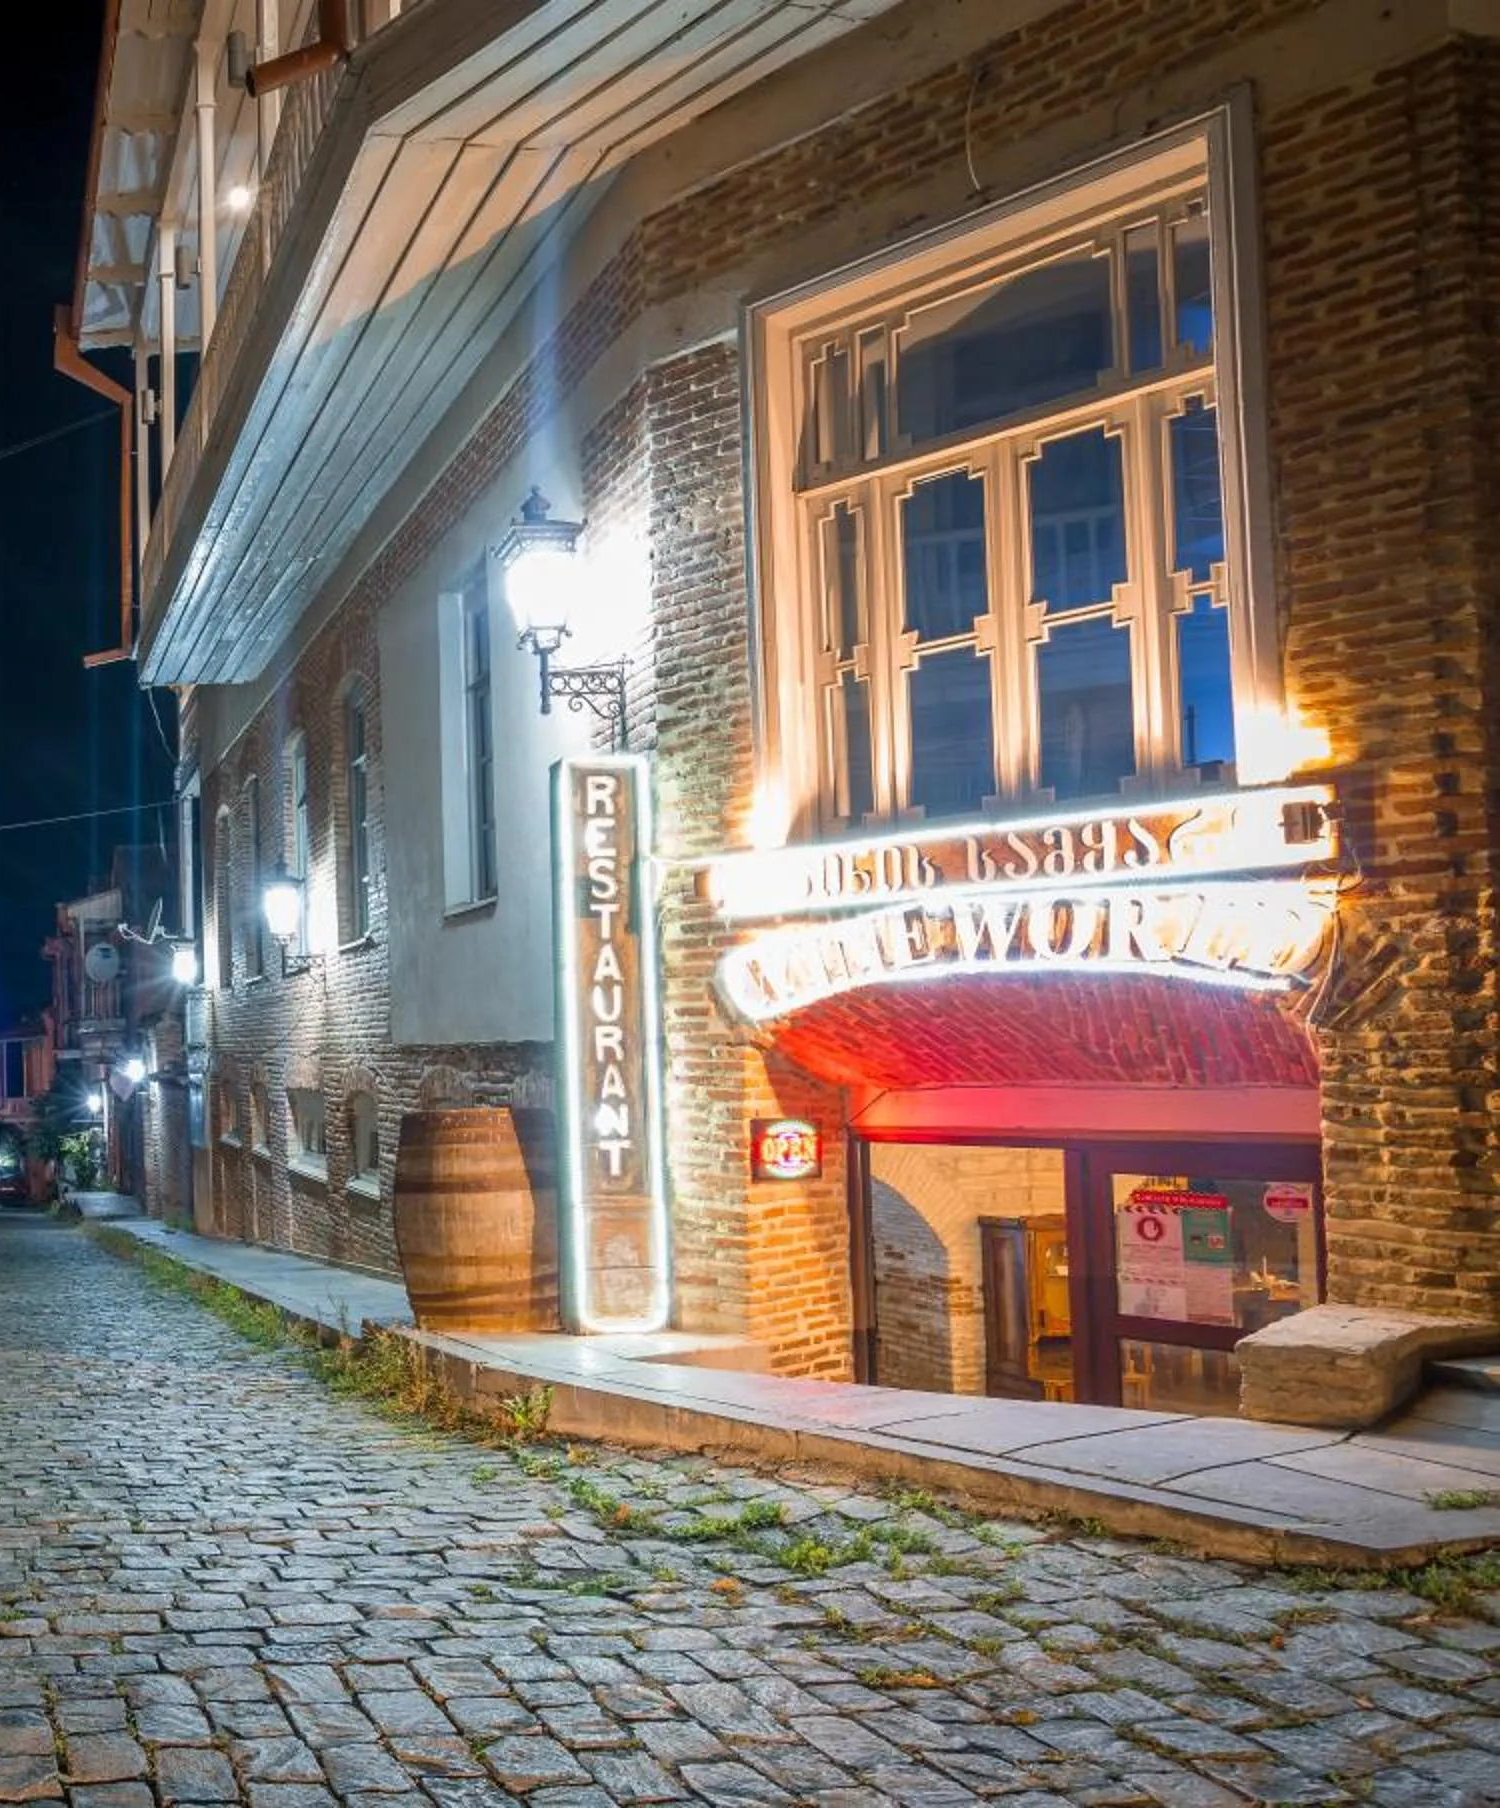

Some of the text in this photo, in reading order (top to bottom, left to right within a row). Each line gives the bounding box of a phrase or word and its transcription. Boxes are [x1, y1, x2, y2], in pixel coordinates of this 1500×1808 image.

[965, 803, 1268, 884] სამყა
[585, 775, 633, 1176] RESTAURANT
[761, 1137, 817, 1163] OPEN
